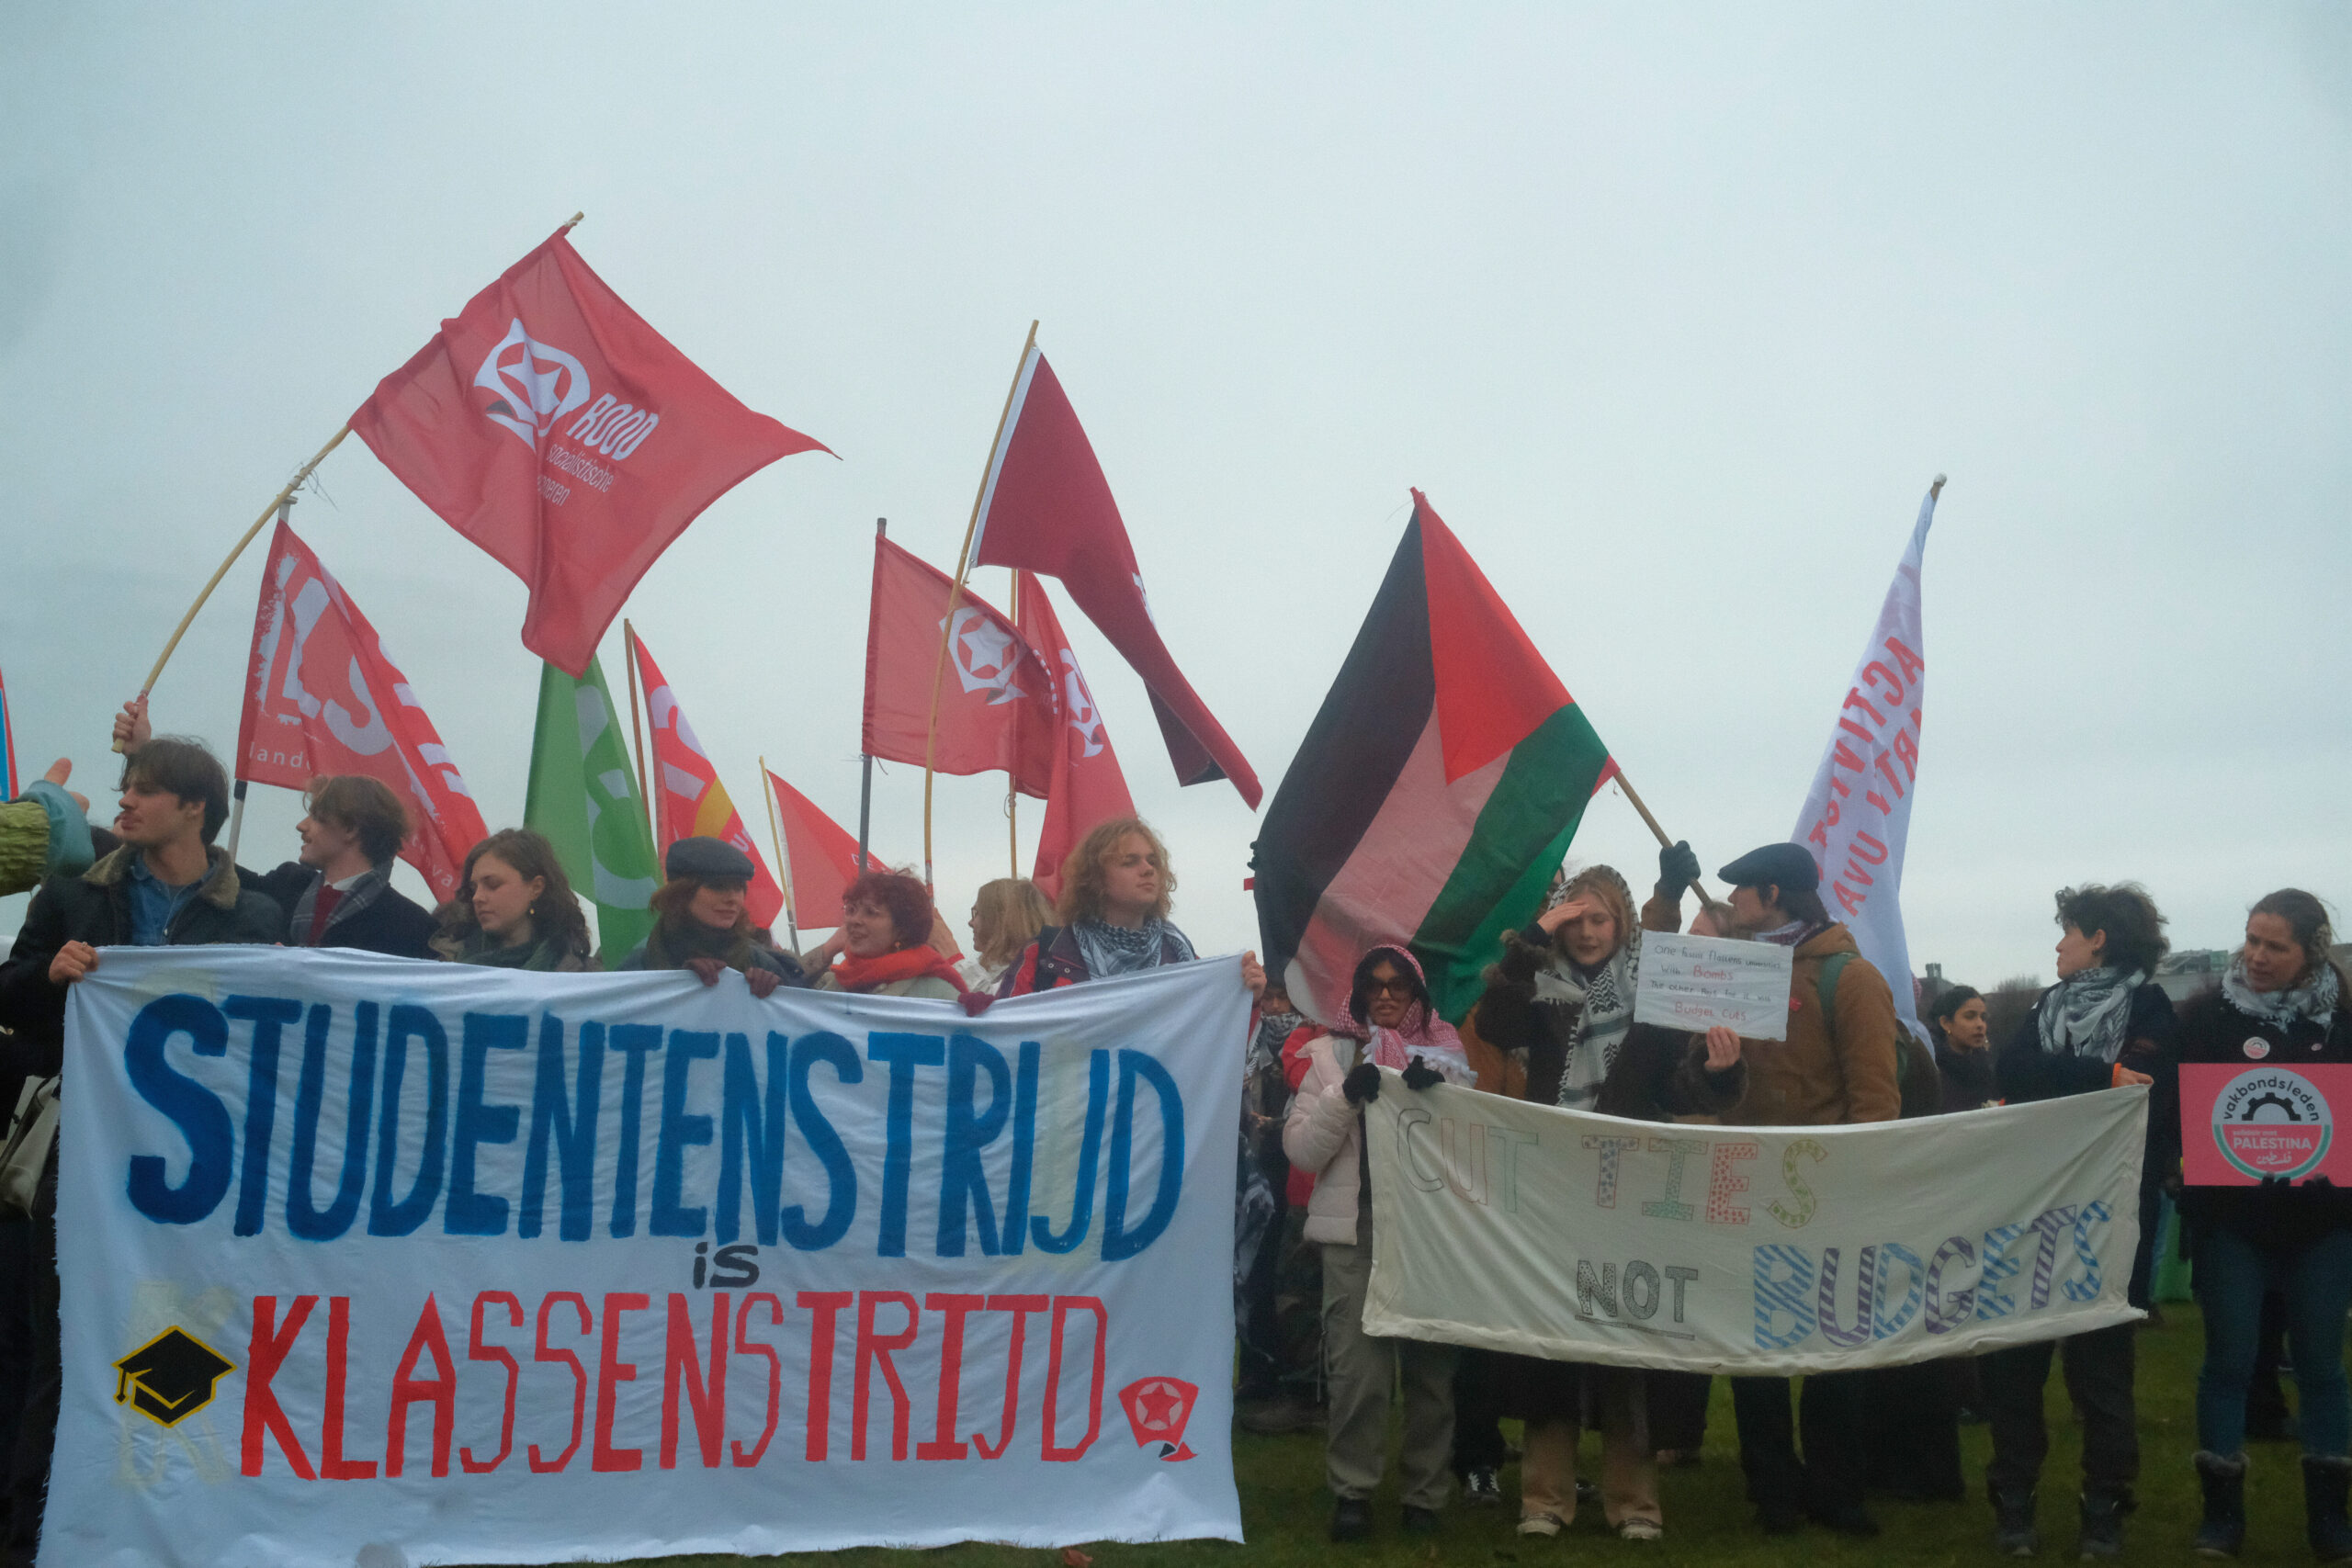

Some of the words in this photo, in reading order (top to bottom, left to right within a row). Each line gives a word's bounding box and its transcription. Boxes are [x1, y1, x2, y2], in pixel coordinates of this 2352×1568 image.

[566, 392, 660, 460] ROOD
[1668, 983, 1694, 993] other
[1693, 965, 1734, 981] Bombs
[1675, 1000, 1715, 1018] Budget
[2223, 1076, 2321, 1122] vakbondsleden
[125, 993, 1185, 1262] STUDENTENSTRIJD
[2233, 1137, 2312, 1149] PALESTINA
[1396, 1108, 1539, 1213] CUT
[1581, 1135, 1828, 1229] TIES
[693, 1241, 761, 1290] is
[1577, 1259, 1699, 1323] NOT
[1753, 1200, 2113, 1350] BUDGETS
[241, 1291, 1108, 1481] KLASSENSTRIJD
